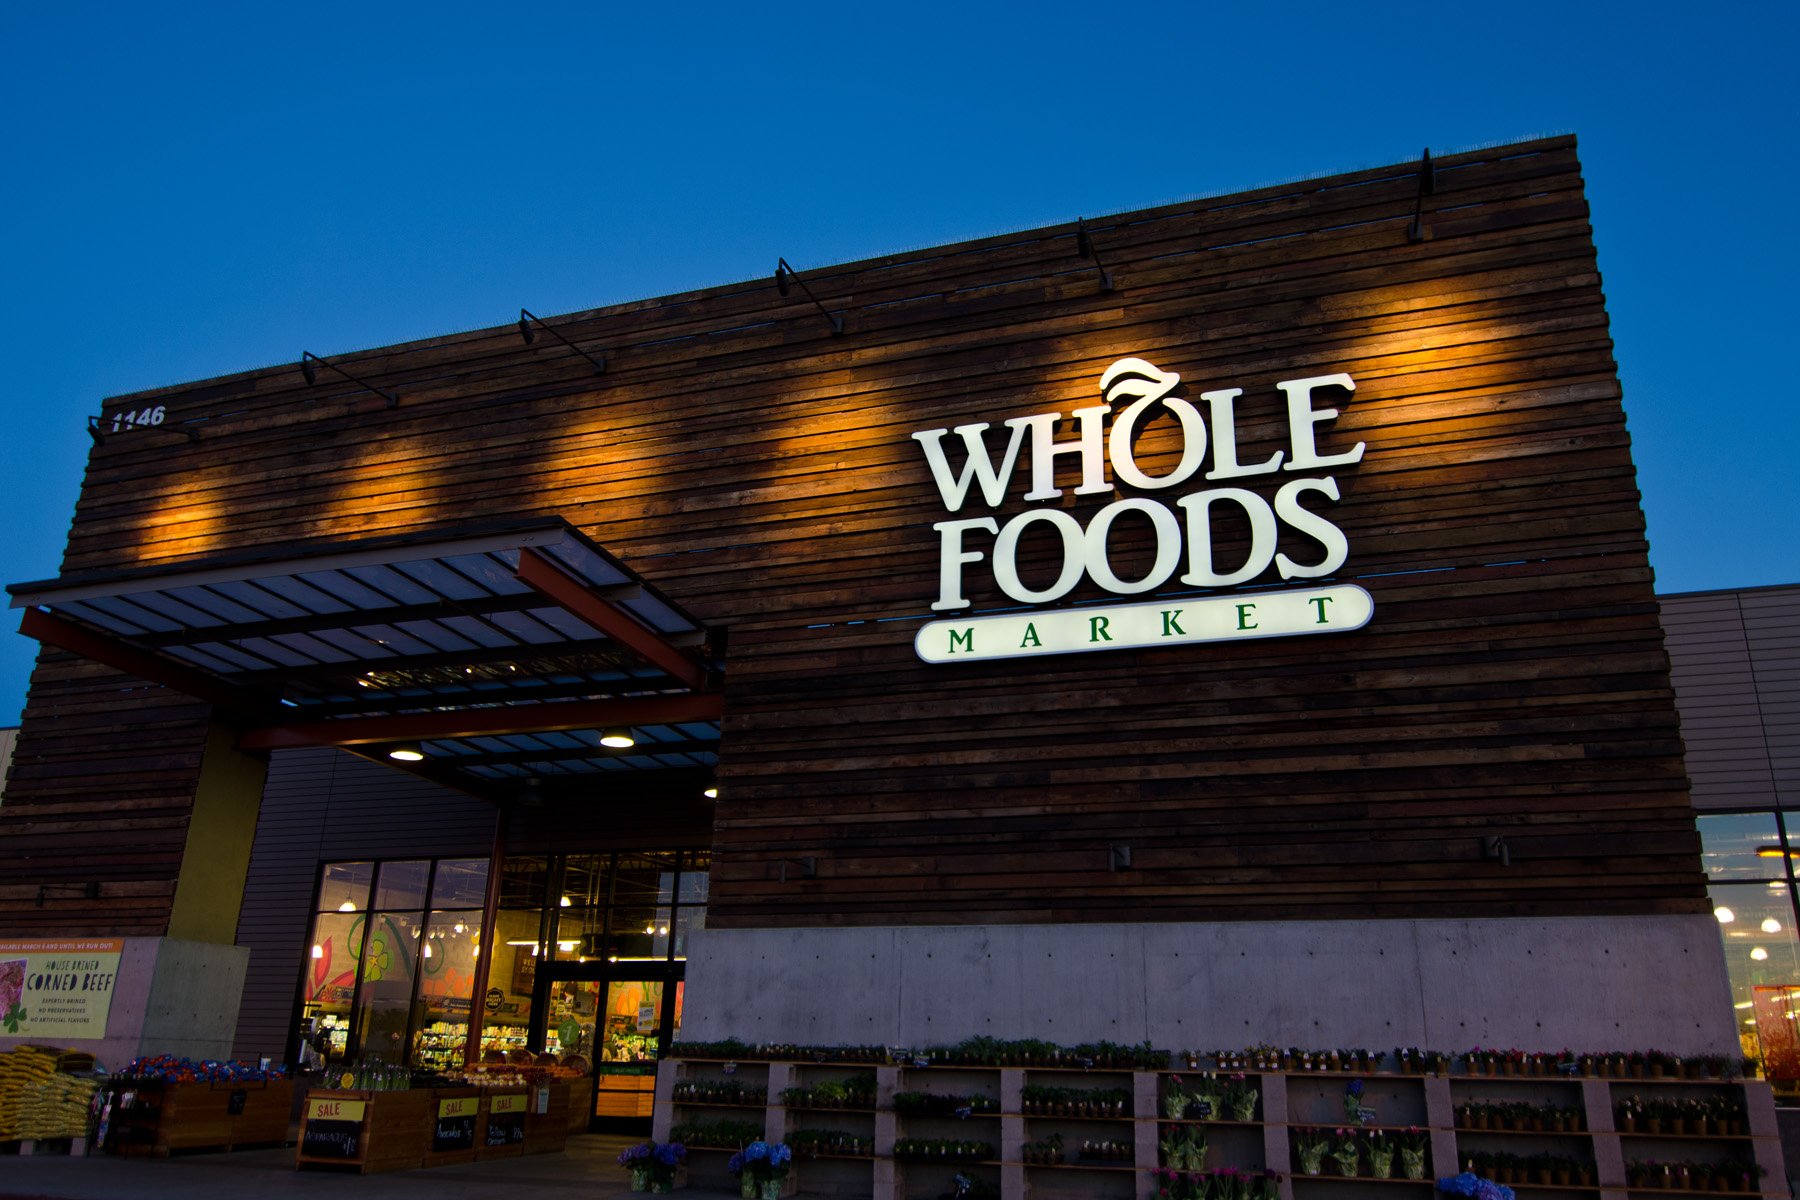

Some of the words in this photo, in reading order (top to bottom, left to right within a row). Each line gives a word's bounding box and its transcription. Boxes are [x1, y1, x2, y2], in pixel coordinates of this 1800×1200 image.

[112, 405, 166, 432] 1146
[911, 357, 1366, 513] WHOLE
[930, 476, 1349, 611] FOODS
[947, 596, 1334, 654] MARKET
[46, 960, 70, 971] HOUSE
[71, 960, 99, 971] BRINED
[27, 973, 78, 991] CORNED
[82, 973, 113, 991] BEEF
[317, 1102, 341, 1117] SALE
[445, 1100, 463, 1115] SALE
[496, 1097, 512, 1111] SALE
